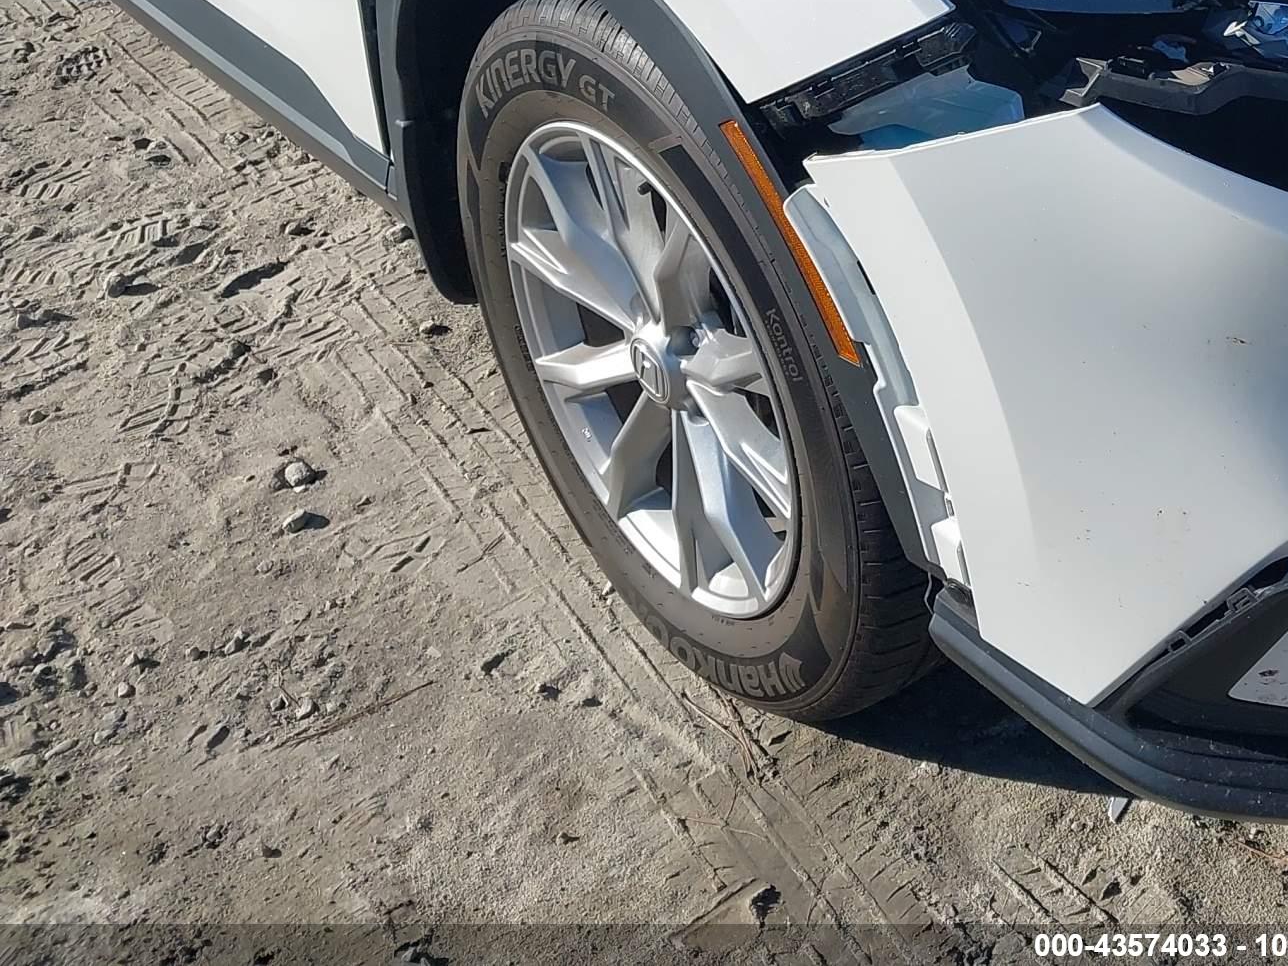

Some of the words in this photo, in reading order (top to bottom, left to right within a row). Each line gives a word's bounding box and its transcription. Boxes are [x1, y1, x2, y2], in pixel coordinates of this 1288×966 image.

[475, 48, 577, 120] KINERGY
[579, 74, 615, 113] GT
[766, 307, 803, 382] Kontrol
